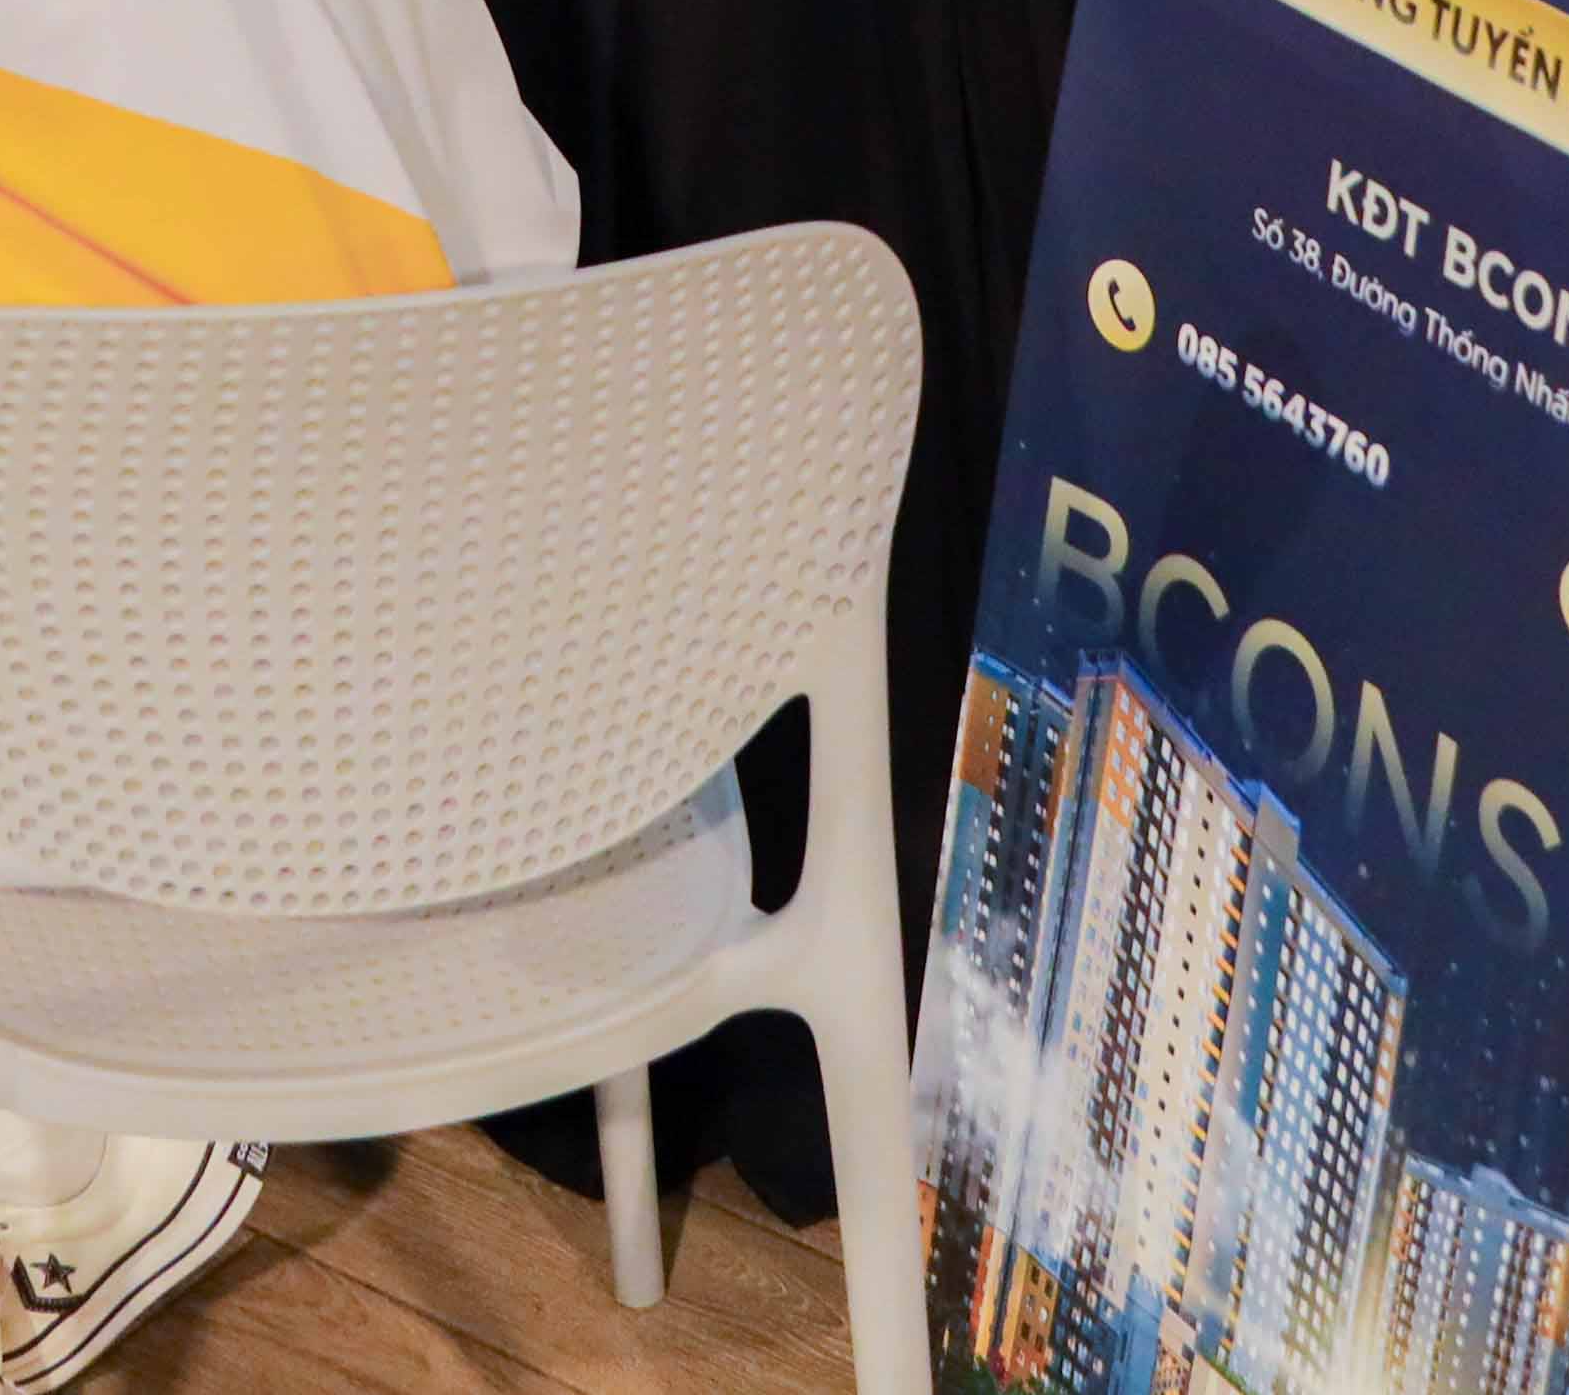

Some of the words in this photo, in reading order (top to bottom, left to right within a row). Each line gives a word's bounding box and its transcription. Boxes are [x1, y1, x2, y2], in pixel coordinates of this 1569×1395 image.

[1326, 158, 1430, 258] KĐT
[1252, 208, 1284, 250] Số
[1289, 228, 1324, 280] 38,
[1331, 255, 1417, 334] Đường
[1424, 307, 1510, 391] Thống
[1176, 320, 1239, 394] 085
[1243, 343, 1390, 488] 5643760
[1034, 476, 1562, 957] BCONS
